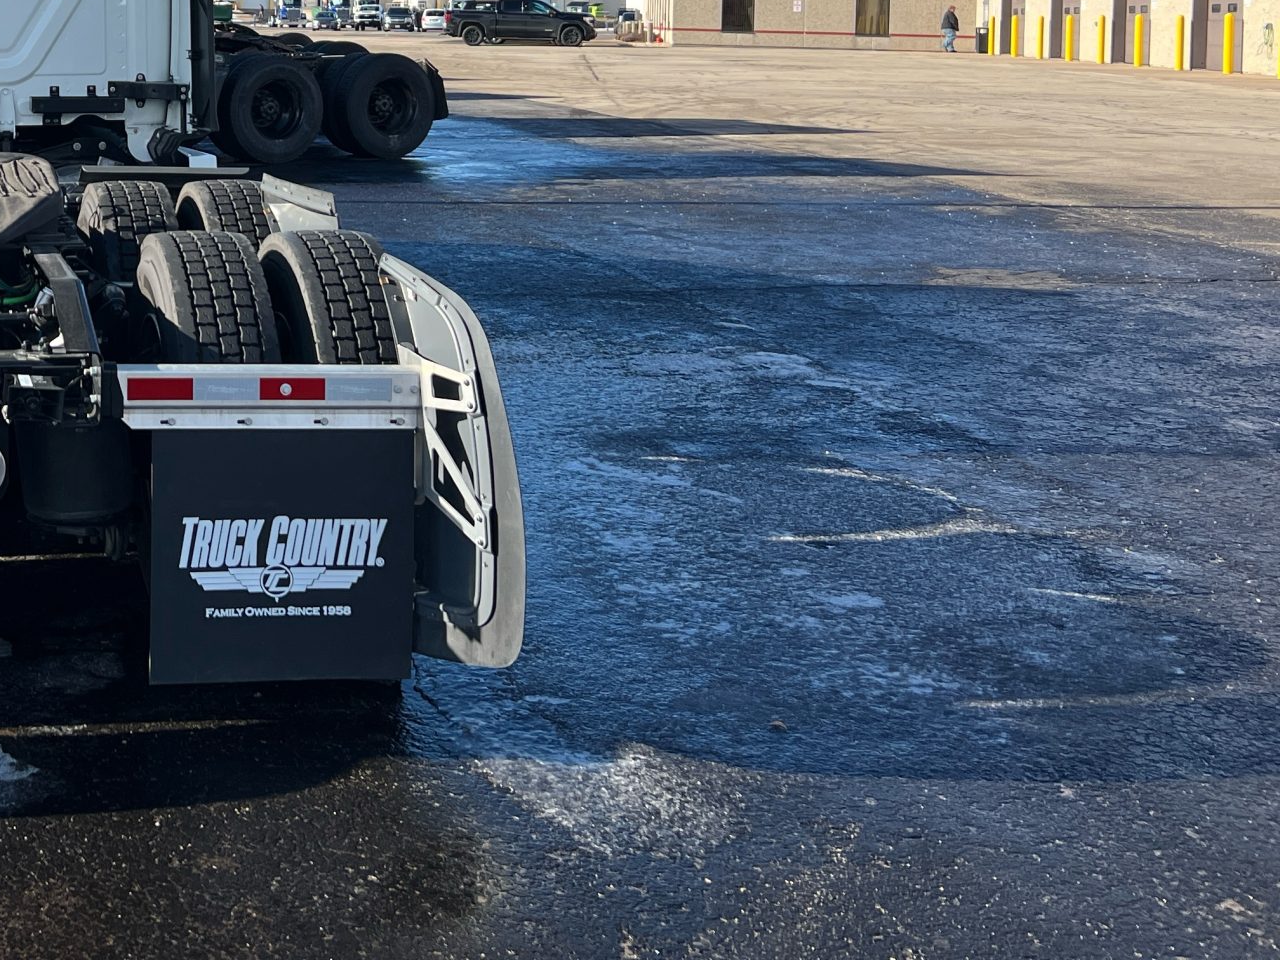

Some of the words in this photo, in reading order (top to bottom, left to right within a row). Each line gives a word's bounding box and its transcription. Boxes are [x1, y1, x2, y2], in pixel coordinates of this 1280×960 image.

[178, 516, 265, 569] TRUCK
[265, 515, 388, 568] COUNTRY
[205, 606, 245, 618] FAMILY
[245, 606, 286, 617] OWNED
[287, 605, 320, 617] SINCE
[322, 605, 352, 616] 1958
